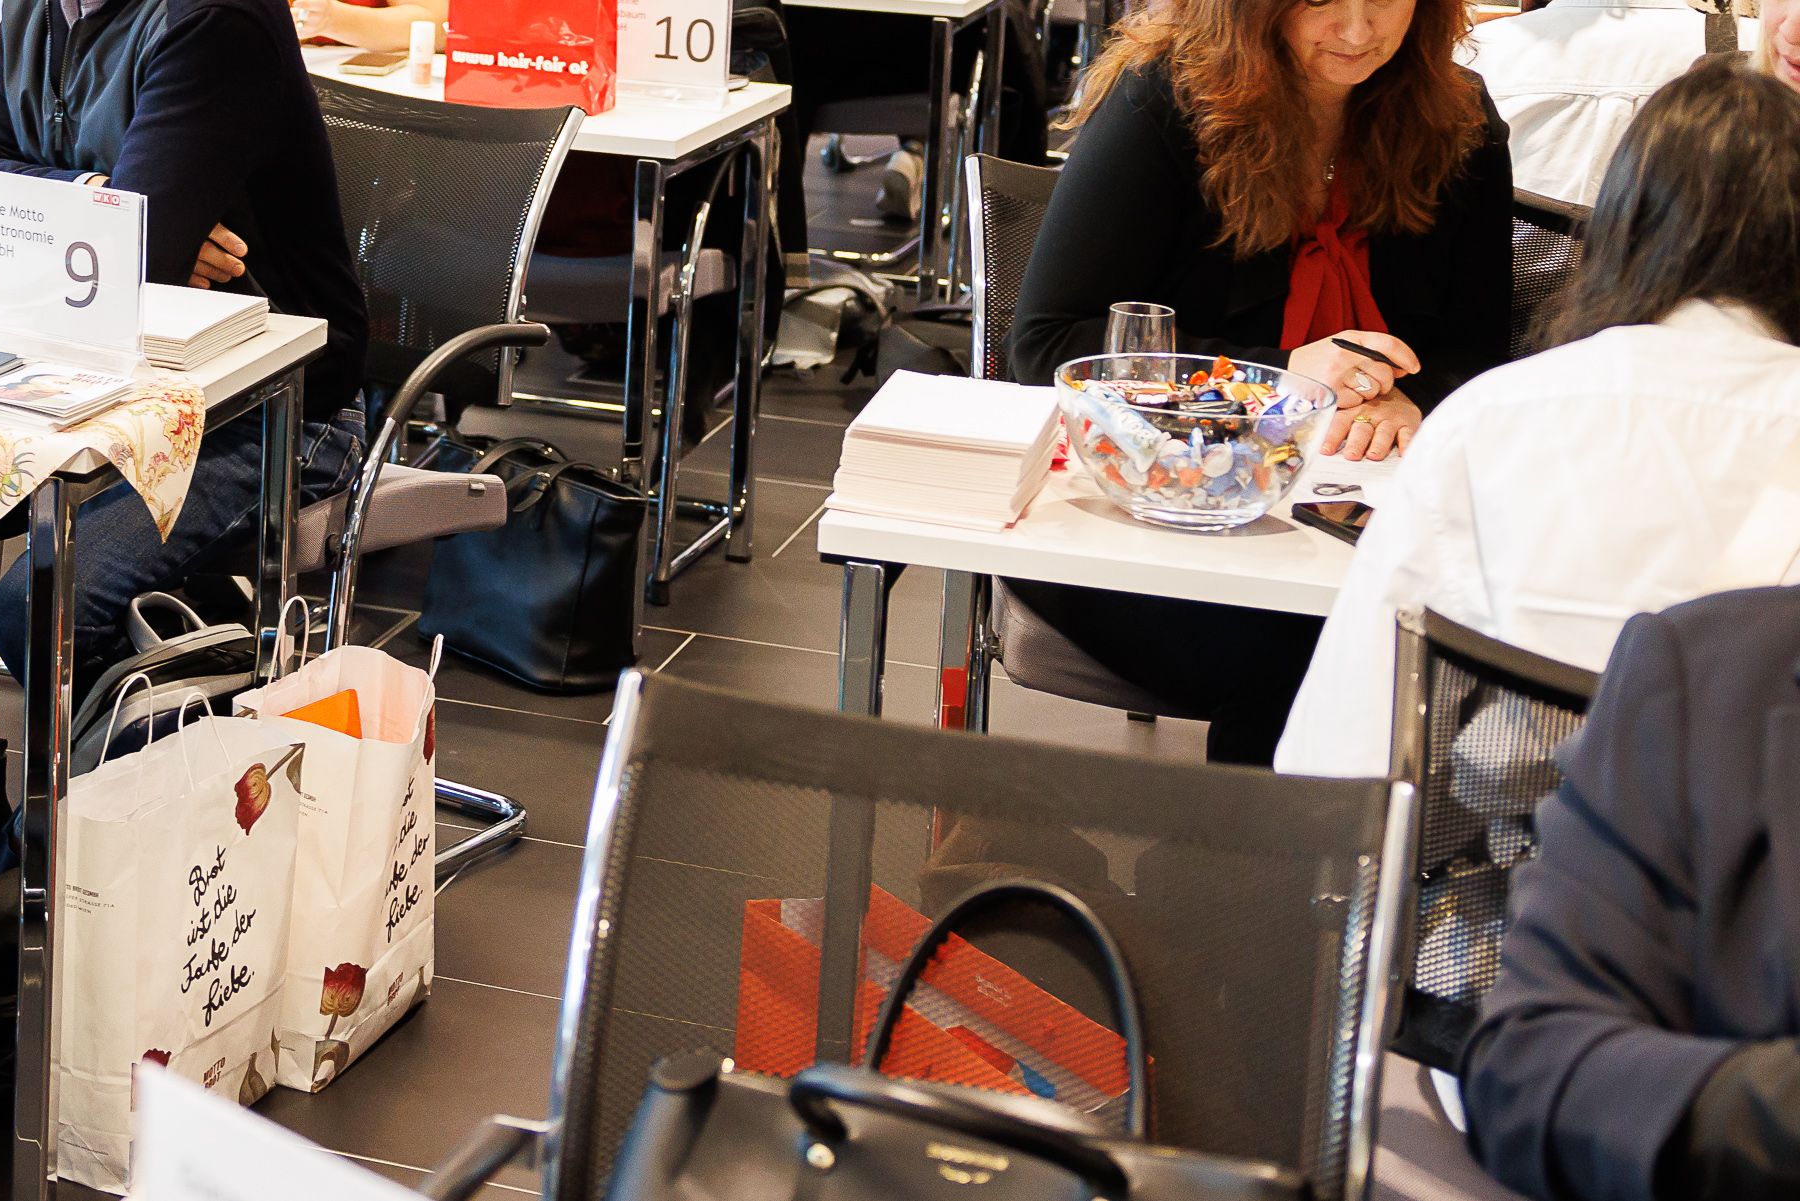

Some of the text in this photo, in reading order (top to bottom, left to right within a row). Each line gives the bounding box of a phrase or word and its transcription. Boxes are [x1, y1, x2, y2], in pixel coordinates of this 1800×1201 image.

[654, 16, 715, 63] 10
[9, 206, 45, 223] Motto
[93, 191, 121, 206] WKO
[65, 241, 99, 308] 9
[189, 845, 227, 907] Brot
[187, 884, 238, 947] ist die
[181, 908, 257, 994] Farbe der
[202, 964, 255, 1027] Liebe.
